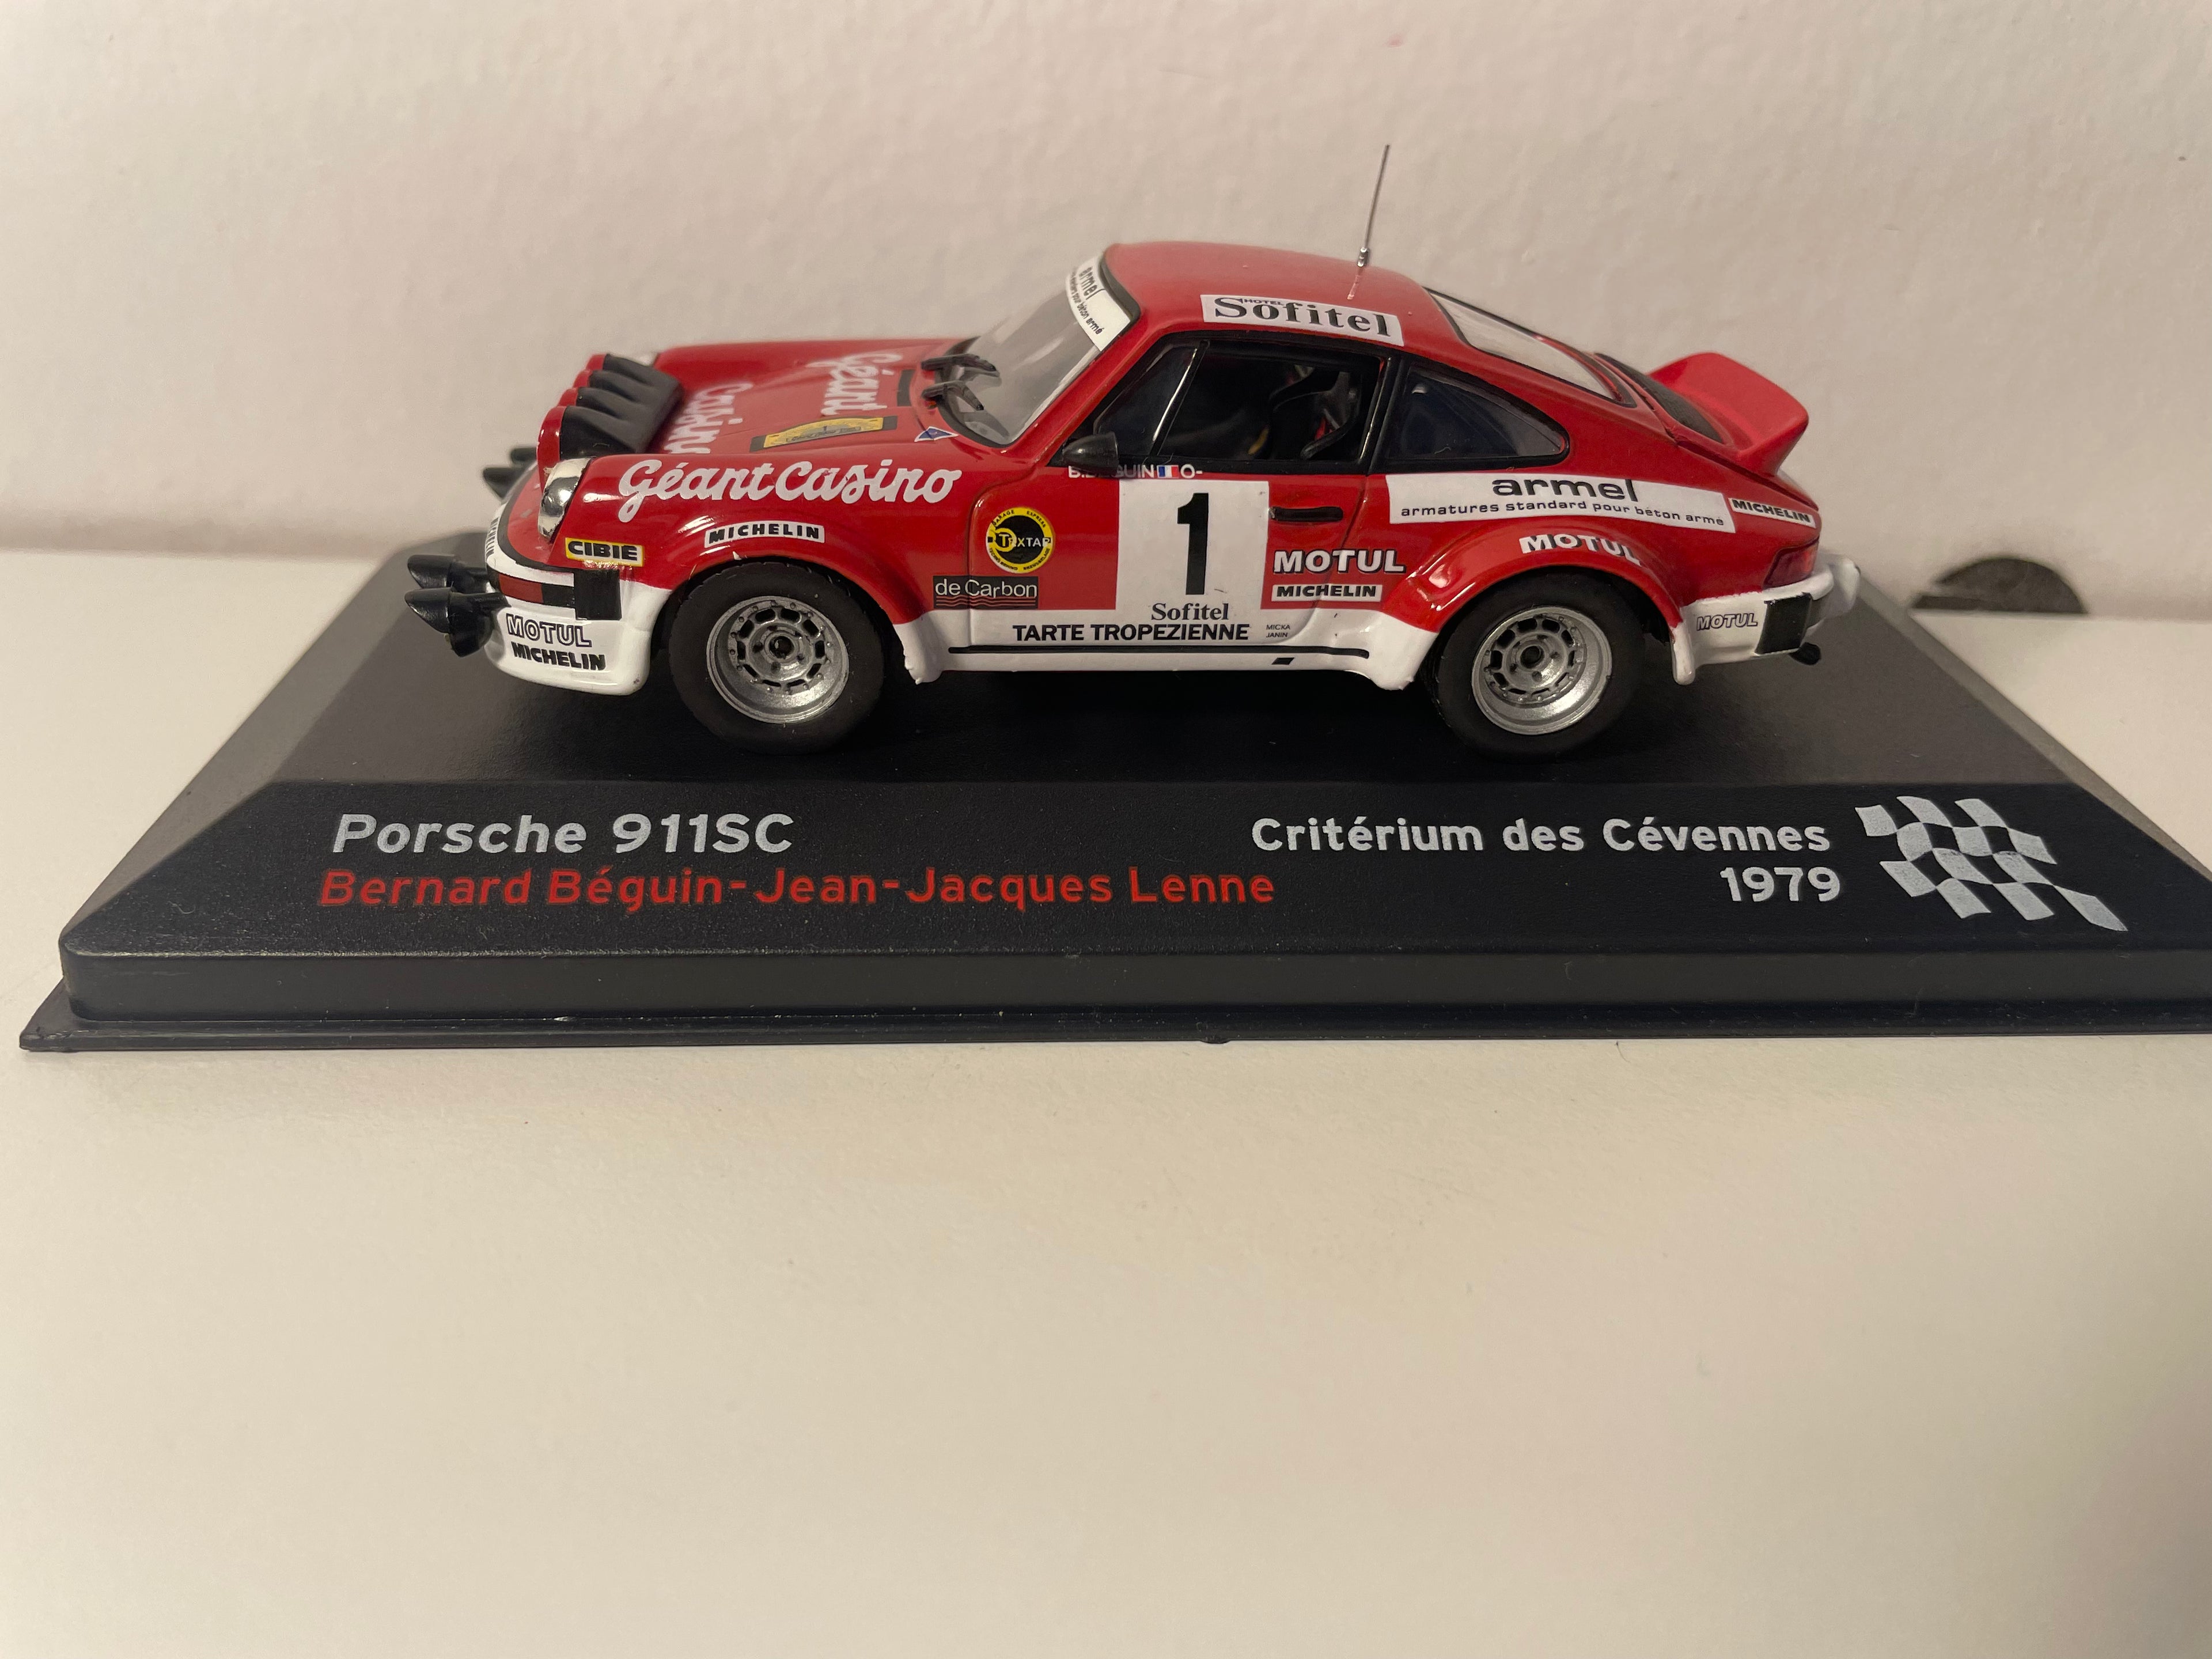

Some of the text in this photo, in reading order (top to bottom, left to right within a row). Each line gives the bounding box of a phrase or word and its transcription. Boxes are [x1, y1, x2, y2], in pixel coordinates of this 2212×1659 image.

[1243, 298, 1284, 306] HOTEL
[1214, 297, 1391, 337] Sofitel
[1492, 479, 1639, 502] armel
[1401, 501, 1724, 526] armatures standard pour béton armé
[1732, 499, 1811, 523] MICHELIN
[708, 522, 820, 544] MICHELIN
[1177, 493, 1209, 595] 1
[1272, 549, 1407, 574] MOTUL
[1519, 533, 1642, 567] MOTUL
[935, 578, 1037, 599] de Carbon
[1276, 585, 1377, 598] MICHELIN
[1151, 603, 1229, 621] Sofitel
[1696, 612, 1758, 631] MOTUL
[506, 613, 592, 648] MOTUL
[1013, 624, 1250, 641] TARTE TROPEZIENNE
[511, 641, 606, 671] MICHELIN
[332, 813, 795, 854] Porsche 911SC
[1252, 816, 1831, 852] Critérium des Cévennes
[319, 867, 532, 908] Bernard
[1130, 866, 1275, 904] Lenne
[1719, 866, 1842, 903] 1979
